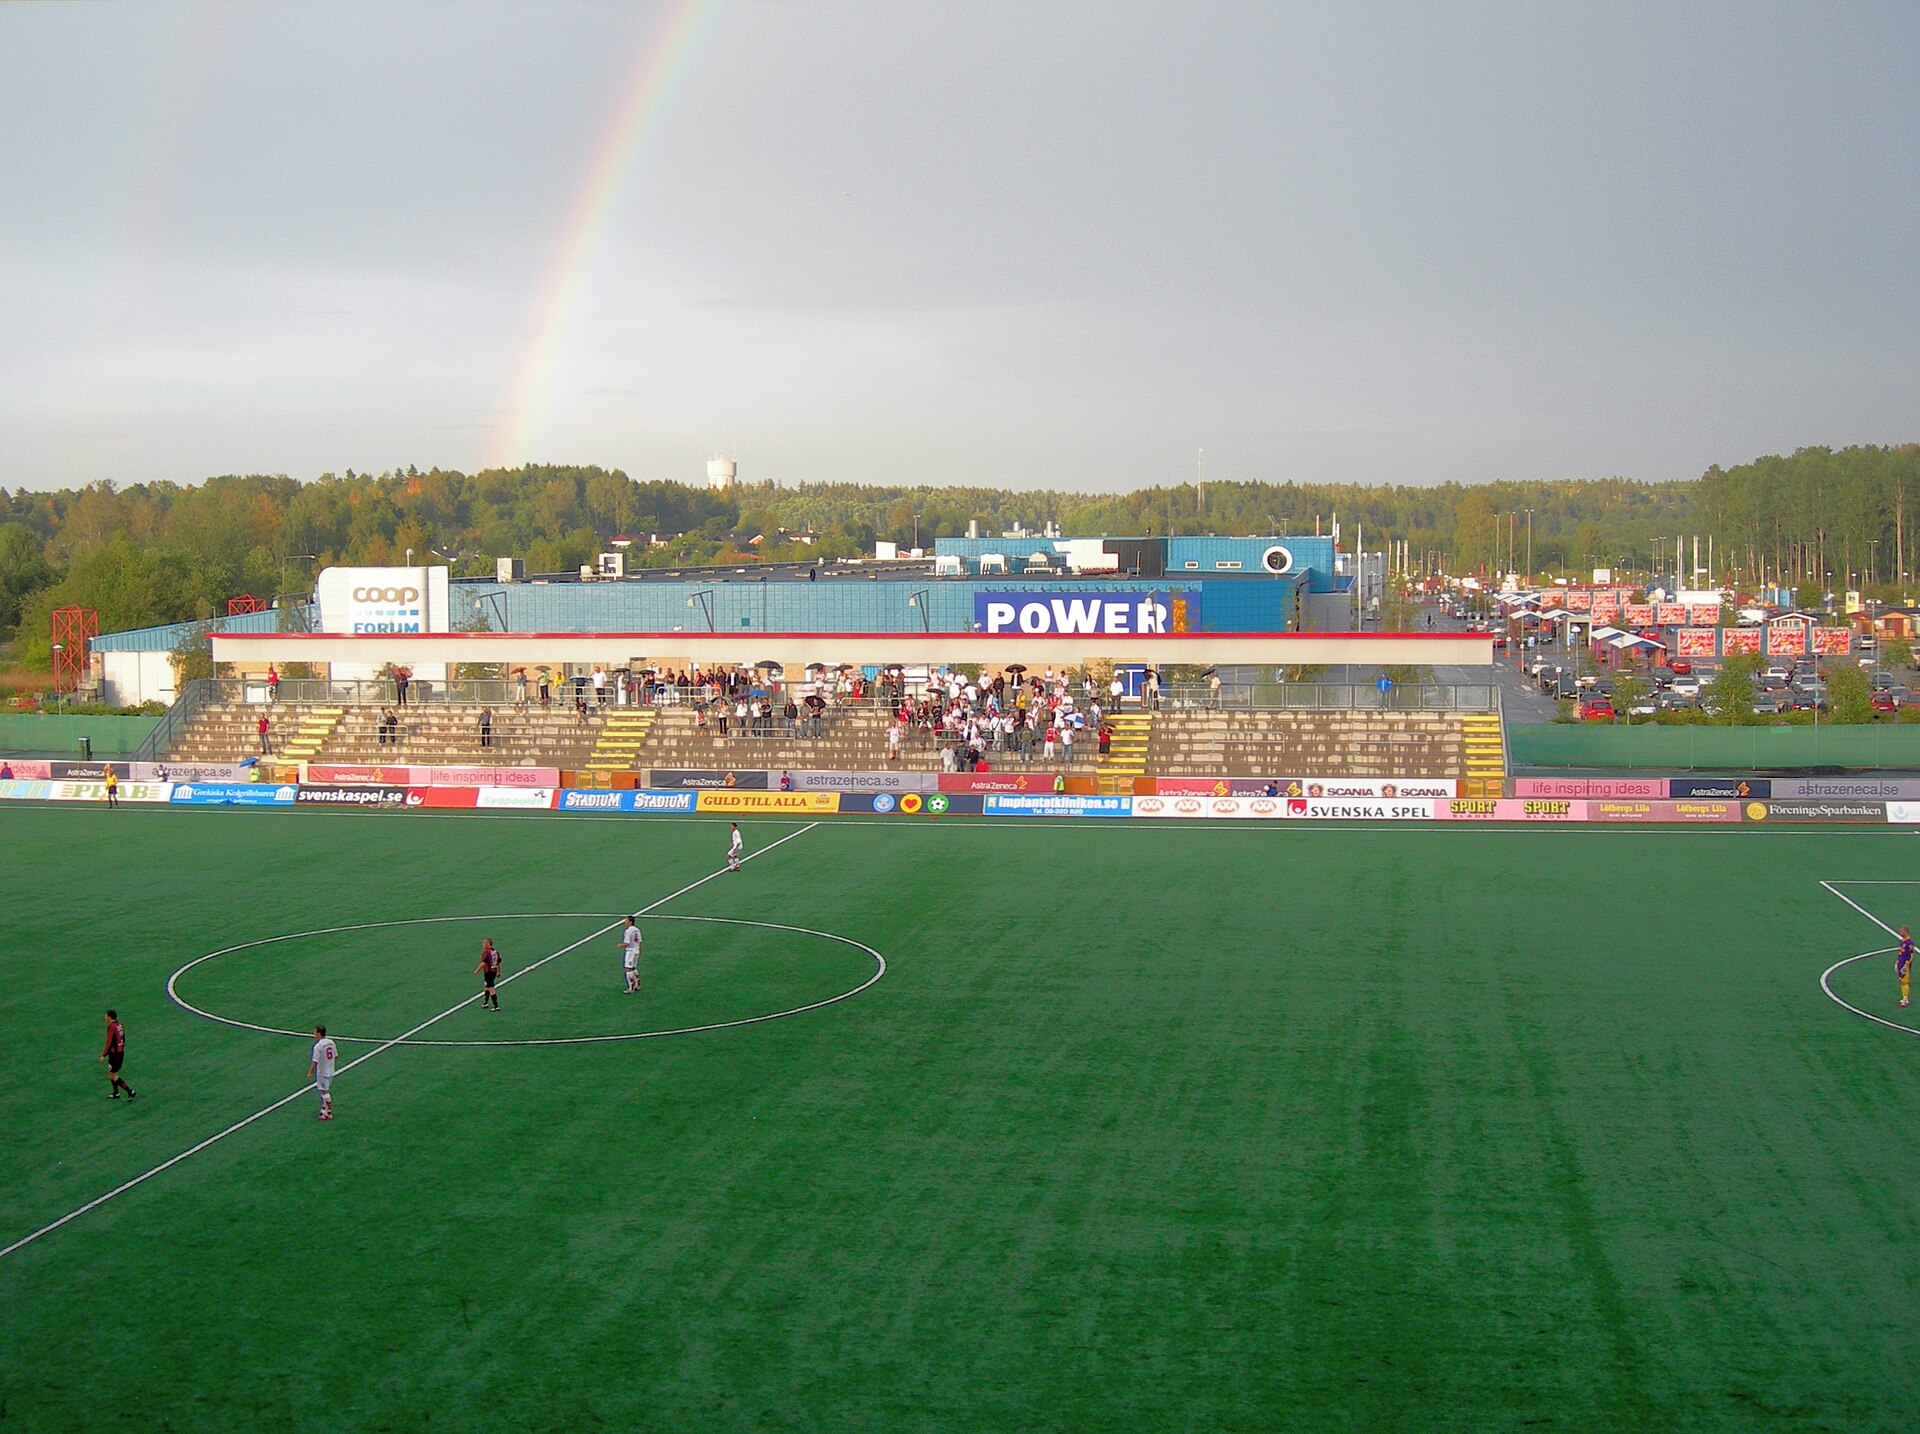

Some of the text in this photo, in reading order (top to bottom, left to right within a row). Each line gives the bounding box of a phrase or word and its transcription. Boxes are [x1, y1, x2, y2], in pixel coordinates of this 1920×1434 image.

[352, 586, 419, 606] coop
[987, 599, 1167, 633] POWER
[354, 623, 419, 633] FORUM
[66, 768, 105, 777] AstraZeneca
[152, 766, 232, 777] atrazeneca.se
[334, 773, 375, 781] AstraZeneca
[433, 770, 537, 785] life inspiring ideas
[682, 778, 726, 787] AstraZeneca
[806, 775, 900, 787] astrazeneca.se
[971, 781, 1018, 790] AstraZeneca
[193, 788, 224, 797] Grekiska
[1327, 787, 1374, 796] SCANIA
[1400, 788, 1448, 797] SCANIA
[1532, 782, 1650, 798] life inspiring ideas
[1690, 787, 1740, 797] AstraZeneca
[1798, 783, 1899, 796] astrazeneca.se
[298, 789, 403, 804] svenskaspel.se
[703, 796, 808, 807] GULD TILL ALLA
[1140, 799, 1163, 812] AXA
[1177, 800, 1200, 812] AXA
[1215, 800, 1238, 813] AXA
[1252, 800, 1276, 813] AXA
[1450, 800, 1497, 814] SPORT
[1523, 801, 1570, 815] SPORT
[1635, 803, 1650, 812] Lila
[1711, 804, 1727, 813] Lila
[1769, 804, 1881, 816] FöreningsSparbanken
[1311, 806, 1430, 818] SVENSKA SPEL
[326, 1047, 333, 1060] 6
